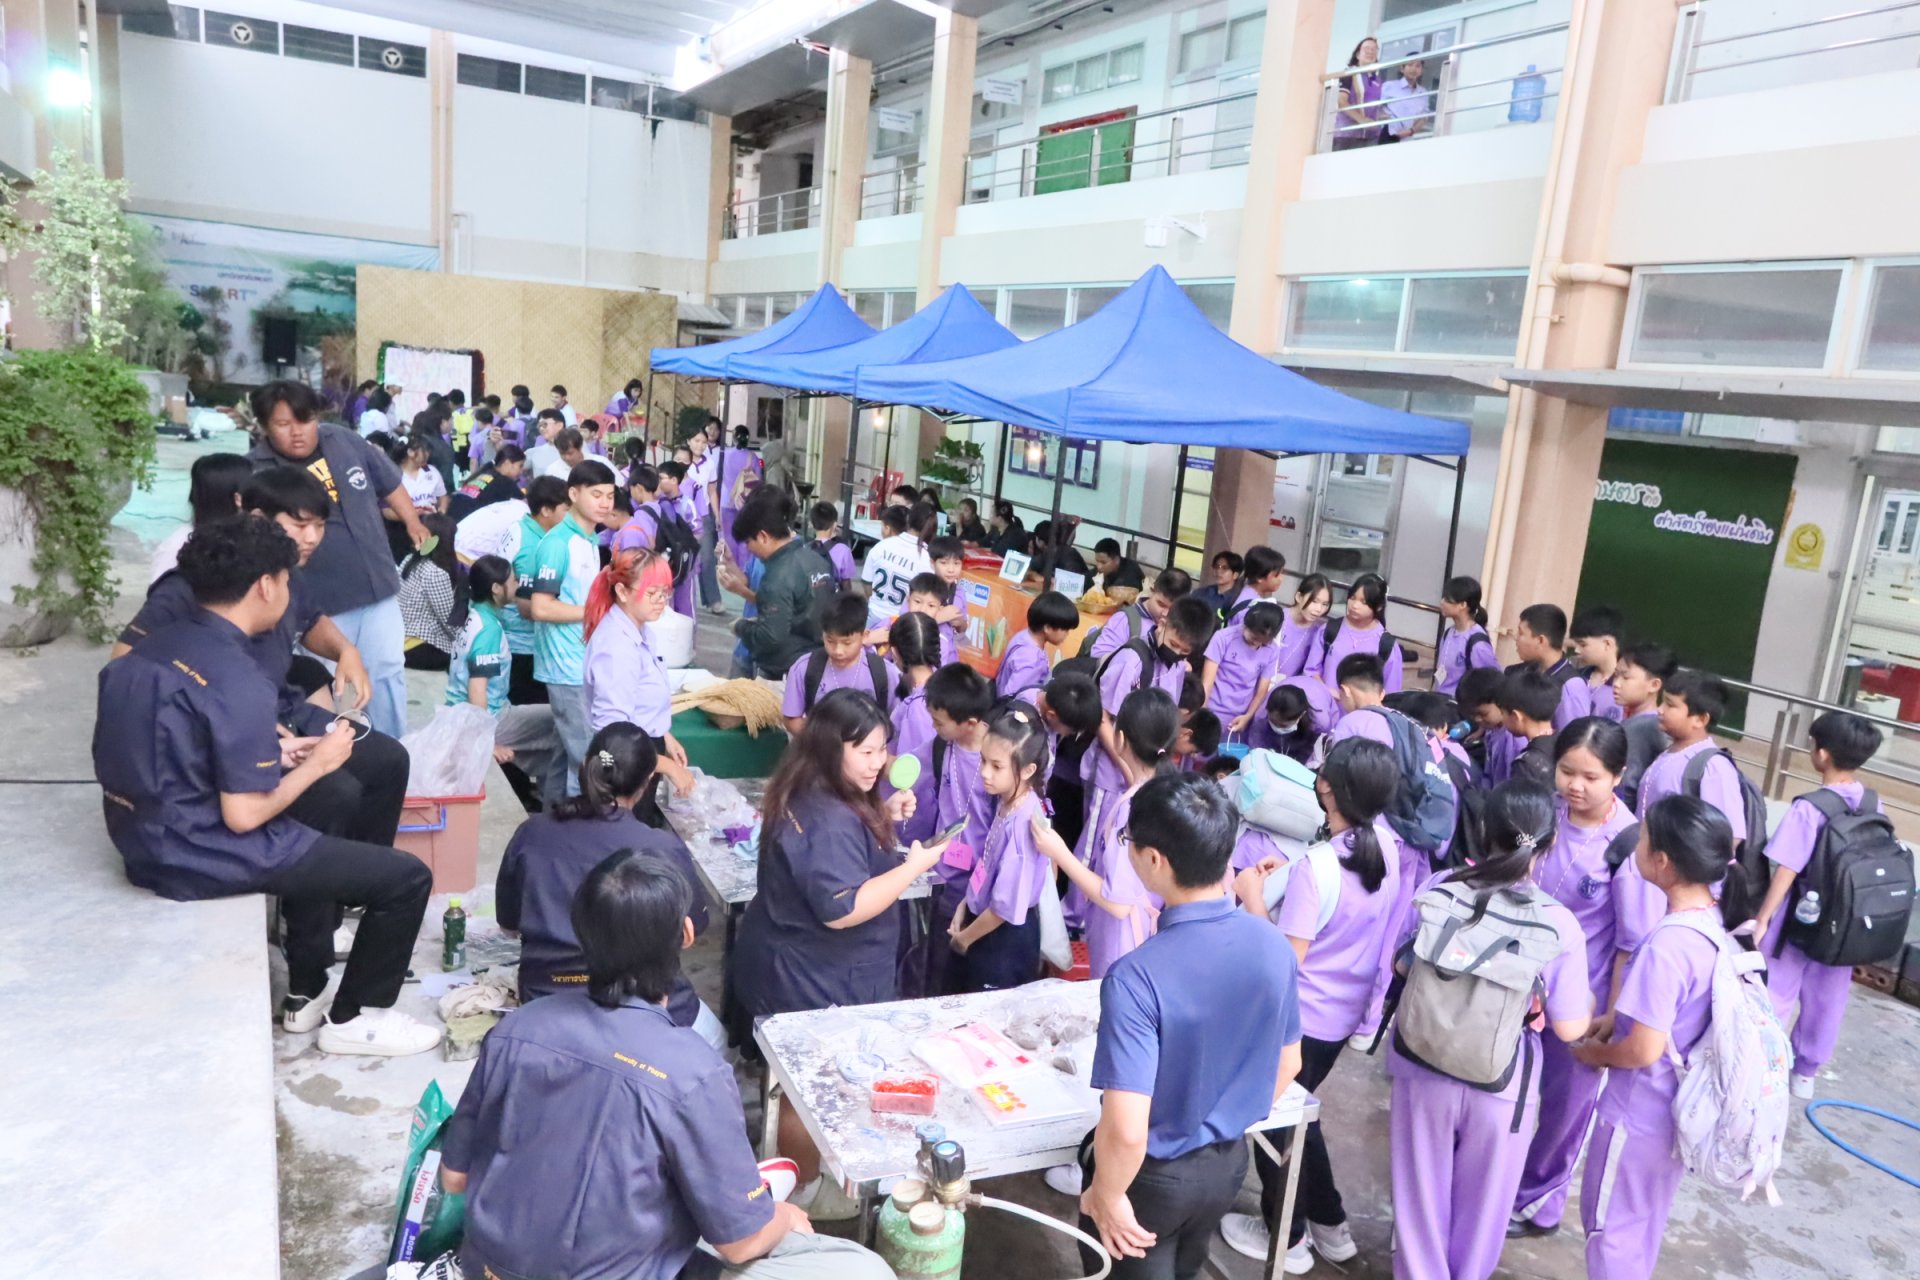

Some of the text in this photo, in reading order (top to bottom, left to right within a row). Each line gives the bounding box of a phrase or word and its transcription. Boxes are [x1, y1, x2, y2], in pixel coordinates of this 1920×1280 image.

[1654, 510, 1773, 544] ศาสตร์ของแผ่นดิน
[872, 567, 912, 606] 25
